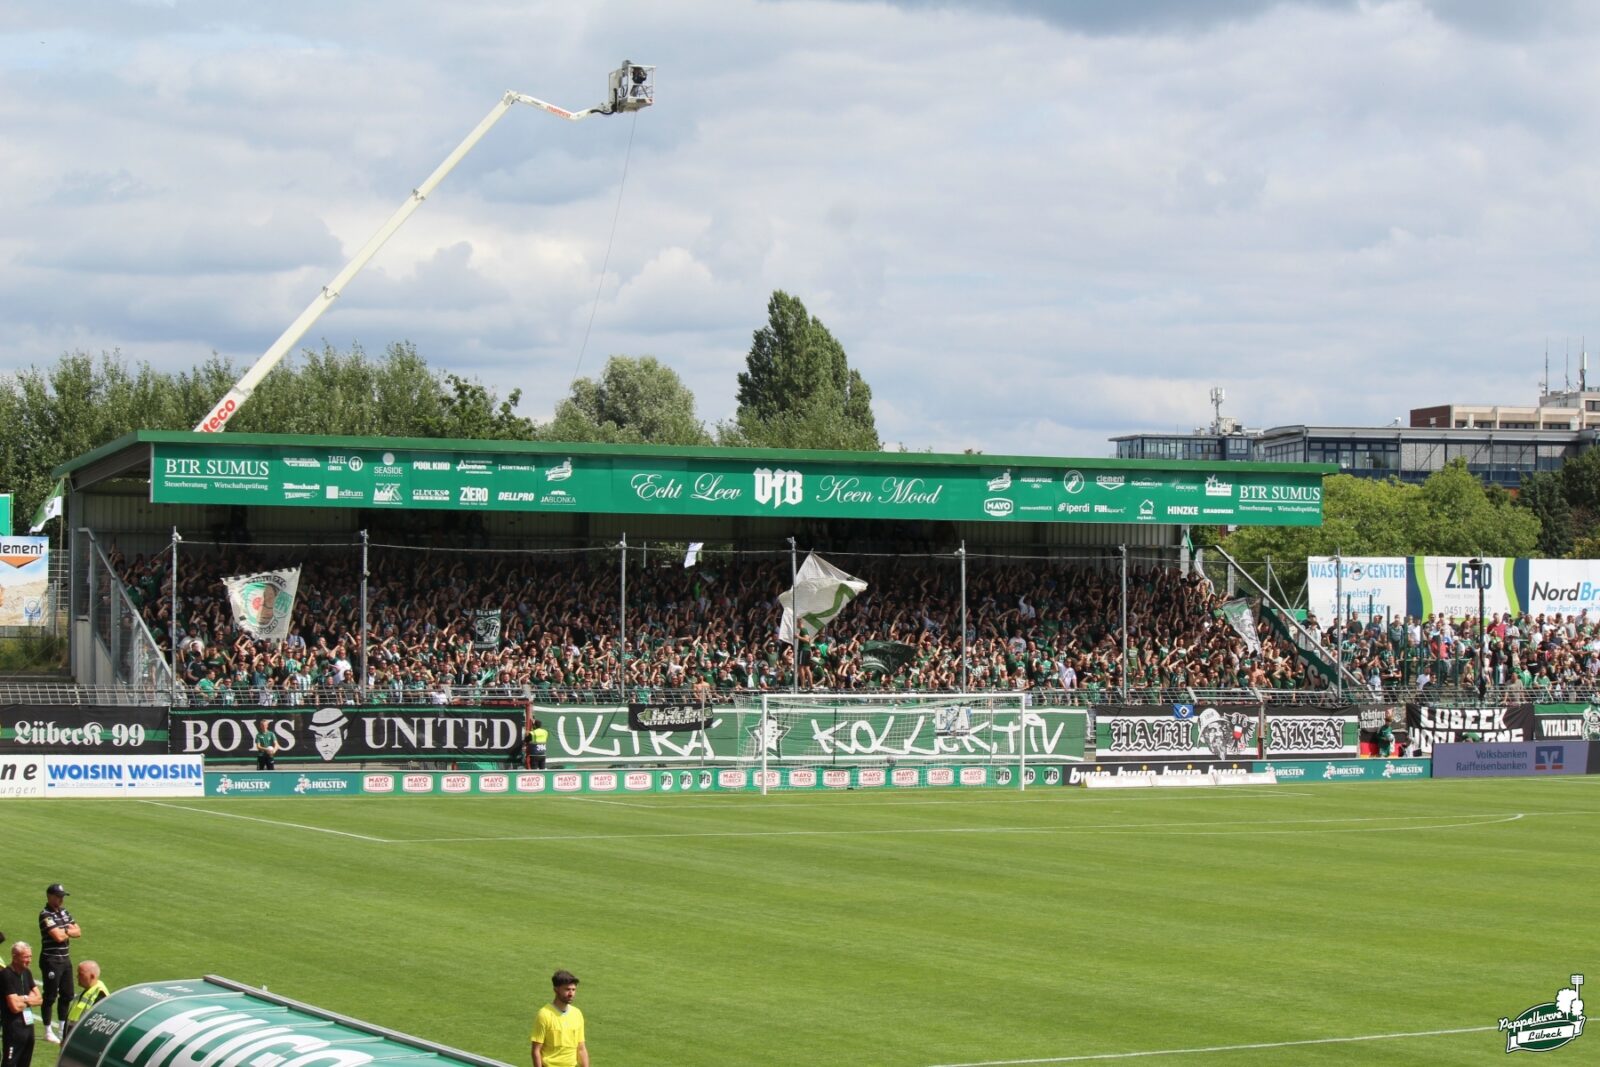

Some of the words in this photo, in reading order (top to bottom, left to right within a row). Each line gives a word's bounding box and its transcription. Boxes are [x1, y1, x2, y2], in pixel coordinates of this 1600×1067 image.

[328, 456, 347, 464] TAFEL
[166, 458, 201, 475] BTR
[206, 459, 269, 476] SUMUS
[374, 466, 403, 474] SEASIDE
[164, 481, 208, 489] Steuerberatung
[630, 473, 683, 501] Echt
[815, 475, 874, 504] Keen
[878, 477, 943, 505] Mood
[498, 492, 534, 502] DELLPRO
[1239, 485, 1268, 499] BTR
[1271, 486, 1320, 500] SUMUS
[987, 502, 1010, 510] MAYO
[1168, 506, 1198, 515] HINZKE
[1310, 564, 1348, 578] WASCH
[1368, 564, 1405, 578] CENTER
[1531, 582, 1600, 601] NordBr
[1541, 719, 1582, 736] VITALIEN
[112, 723, 146, 747] 99
[182, 718, 295, 752] BOYS
[362, 716, 518, 750] UNITED
[1475, 750, 1528, 760] Volksbanken
[1396, 766, 1424, 774] HOLSTEN
[1456, 760, 1527, 772] Raiffeisenbanken
[48, 764, 123, 780] WOISIN
[128, 764, 201, 780] WOISIN
[1024, 770, 1034, 781] fB
[1276, 768, 1305, 776] HOLSTEN
[235, 781, 271, 790] HOLSTEN
[312, 780, 347, 788] HOLSTEN
